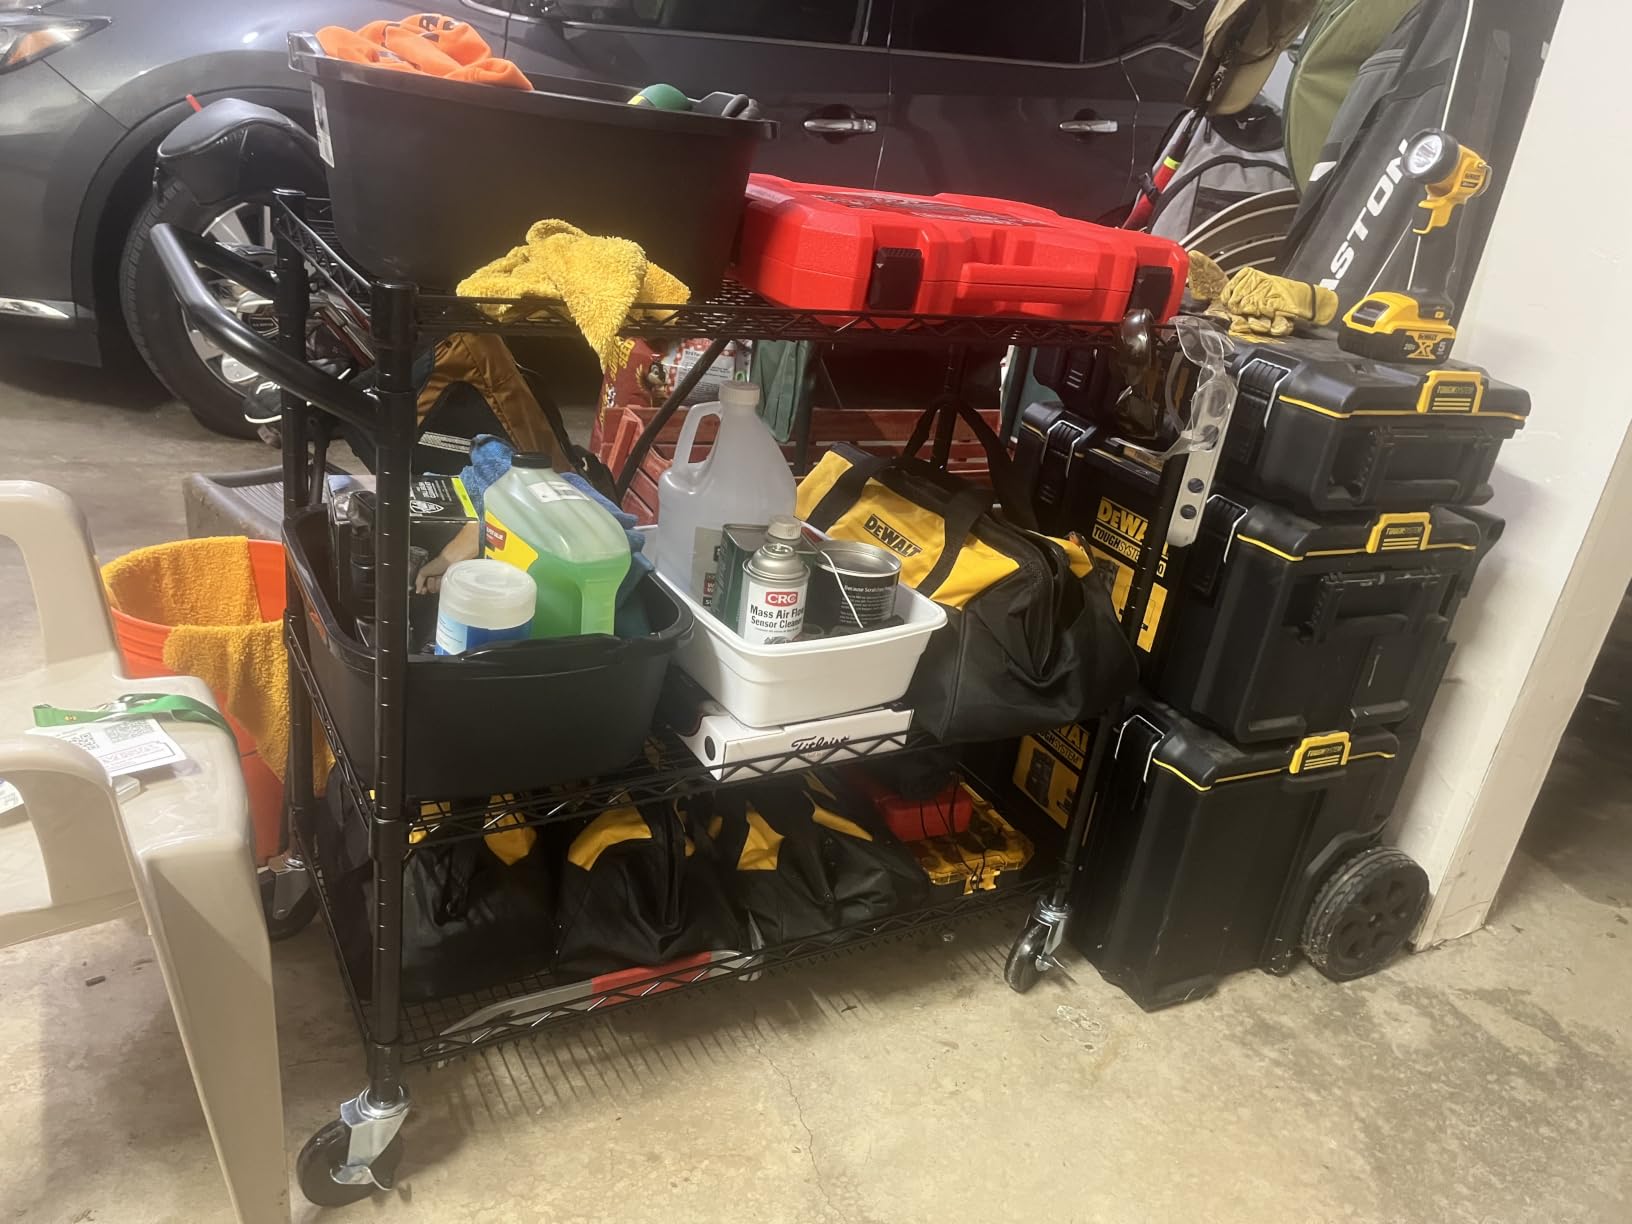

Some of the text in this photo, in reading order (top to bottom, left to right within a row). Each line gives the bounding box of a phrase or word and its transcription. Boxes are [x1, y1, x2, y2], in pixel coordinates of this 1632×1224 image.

[618, 338, 636, 369] SEED
[1097, 500, 1148, 541] DEWA
[1094, 526, 1141, 561] TOUGHSYSTE
[767, 592, 797, 604] CRC
[750, 603, 774, 619] Mass
[775, 609, 790, 620] Air
[751, 615, 802, 629] Sensor Clean
